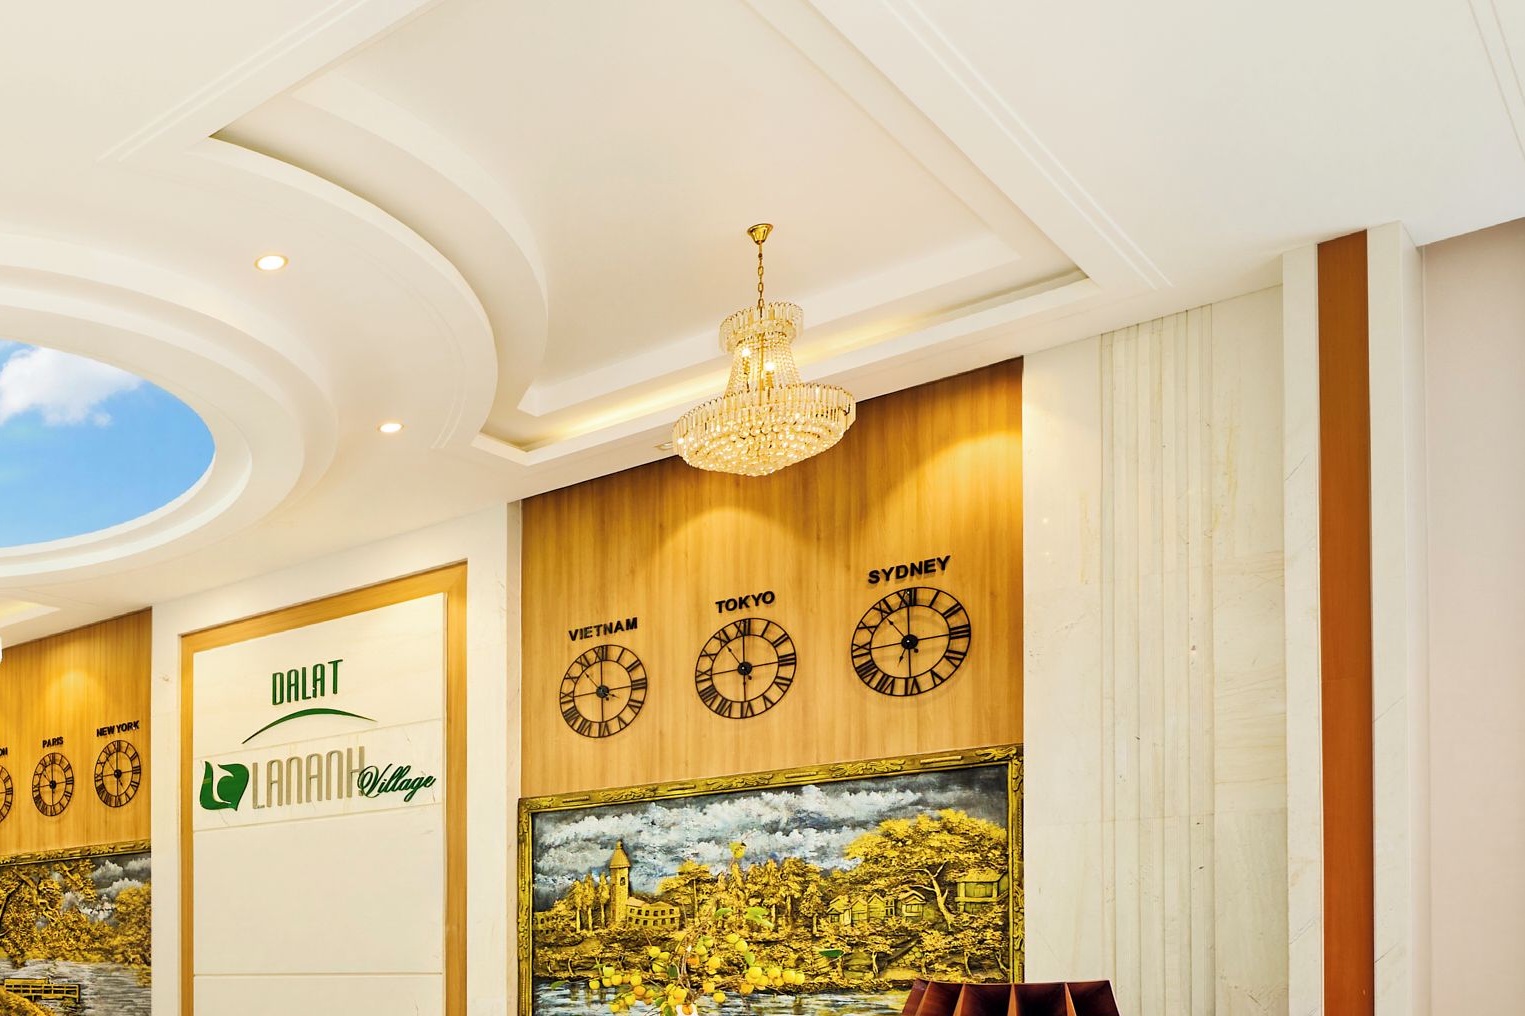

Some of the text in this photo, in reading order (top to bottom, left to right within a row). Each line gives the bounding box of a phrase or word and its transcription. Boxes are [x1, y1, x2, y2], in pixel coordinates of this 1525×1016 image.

[868, 555, 951, 584] SYDNEY
[715, 590, 775, 614] TOKYO
[568, 617, 638, 641] VIETNAM
[272, 659, 343, 705] DALAT
[96, 720, 140, 738] NEW YORK
[42, 736, 63, 748] PARIS
[357, 763, 436, 803] Village
